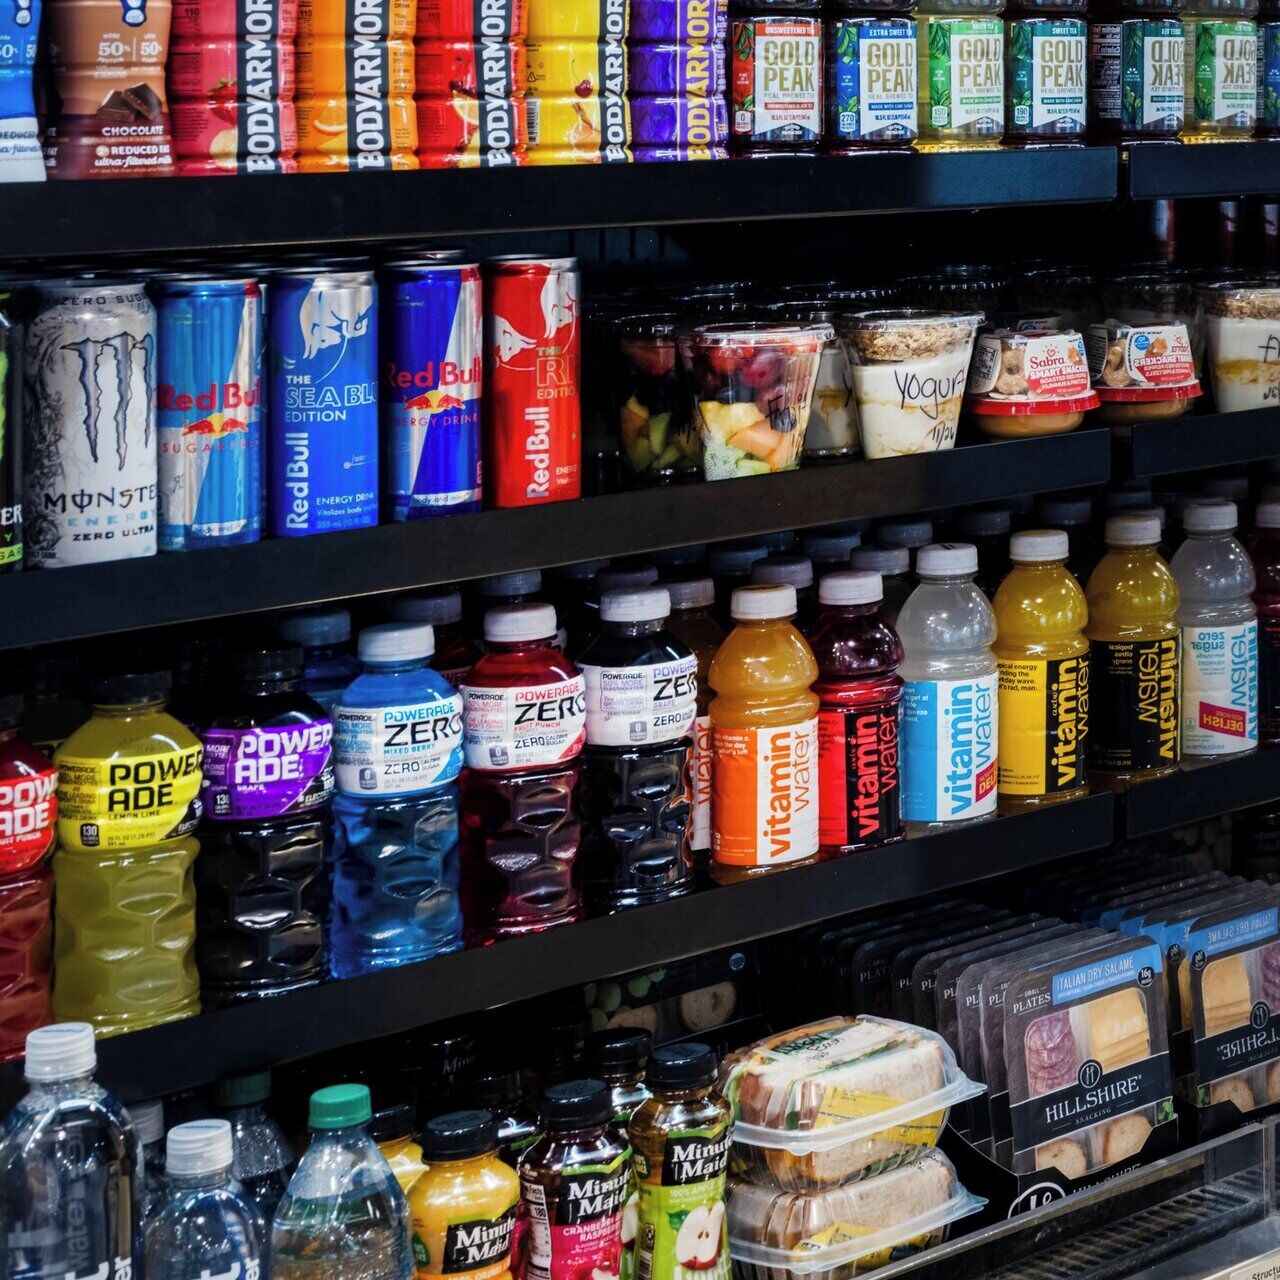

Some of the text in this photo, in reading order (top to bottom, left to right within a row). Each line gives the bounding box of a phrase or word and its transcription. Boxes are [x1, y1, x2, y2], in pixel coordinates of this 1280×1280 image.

[765, 26, 806, 35] UNSWEETENED
[870, 29, 905, 37] EXTRA SWEET
[1052, 27, 1068, 35] SWEET
[764, 41, 814, 65] GOLD
[868, 43, 912, 66] GOLD
[959, 39, 1001, 62] GOLD
[1041, 40, 1083, 63] GOLD
[687, 0, 711, 160] BODYARMOR
[764, 67, 814, 91] PEAK
[868, 69, 913, 92] PEAK
[959, 63, 1001, 87] PEAK
[1041, 65, 1083, 87] PEAK
[842, 115, 854, 123] 270
[1016, 107, 1028, 116] 190
[102, 125, 164, 136] CHOCOLATE
[111, 145, 157, 155] REDUCED
[60, 295, 106, 306] ZERO
[1030, 355, 1066, 370] Sabra
[286, 375, 311, 384] THE
[1030, 368, 1060, 379] SMART
[157, 382, 216, 411] Red
[286, 387, 341, 408] SEA
[286, 410, 346, 422] EDITION
[525, 407, 549, 498] Red Bull
[286, 433, 308, 528] Red Bull
[317, 496, 353, 505] ENERGY
[73, 525, 154, 541] ZERO ULTRA
[602, 672, 643, 680] POWERADE
[1014, 664, 1037, 672] energy
[468, 693, 505, 701] POWERADE
[515, 682, 580, 702] POWERADE
[1077, 658, 1089, 741] water
[338, 713, 373, 721] POWERADE
[384, 702, 454, 722] POWERADE
[514, 692, 585, 725] ZERO
[384, 712, 462, 747] ZERO
[514, 723, 534, 732] FRUIT
[653, 713, 681, 726] ZERO
[974, 683, 991, 768] water
[1051, 659, 1077, 786] vitamin
[238, 723, 333, 758] POWER
[384, 744, 435, 755] MIXED BERRY
[515, 737, 545, 749] ZERO
[944, 684, 973, 815] vitamin
[880, 713, 897, 793] water
[110, 748, 203, 785] POWER
[235, 754, 299, 784] ADE
[384, 761, 420, 775] ZERO
[795, 732, 810, 813] water
[852, 715, 877, 837] vitamin
[109, 783, 173, 812] ADE
[764, 731, 791, 858] vitamin
[109, 810, 160, 820] LEMON LIME
[1013, 992, 1051, 1013] PLATES
[1045, 1076, 1140, 1123] HILLSHIRE
